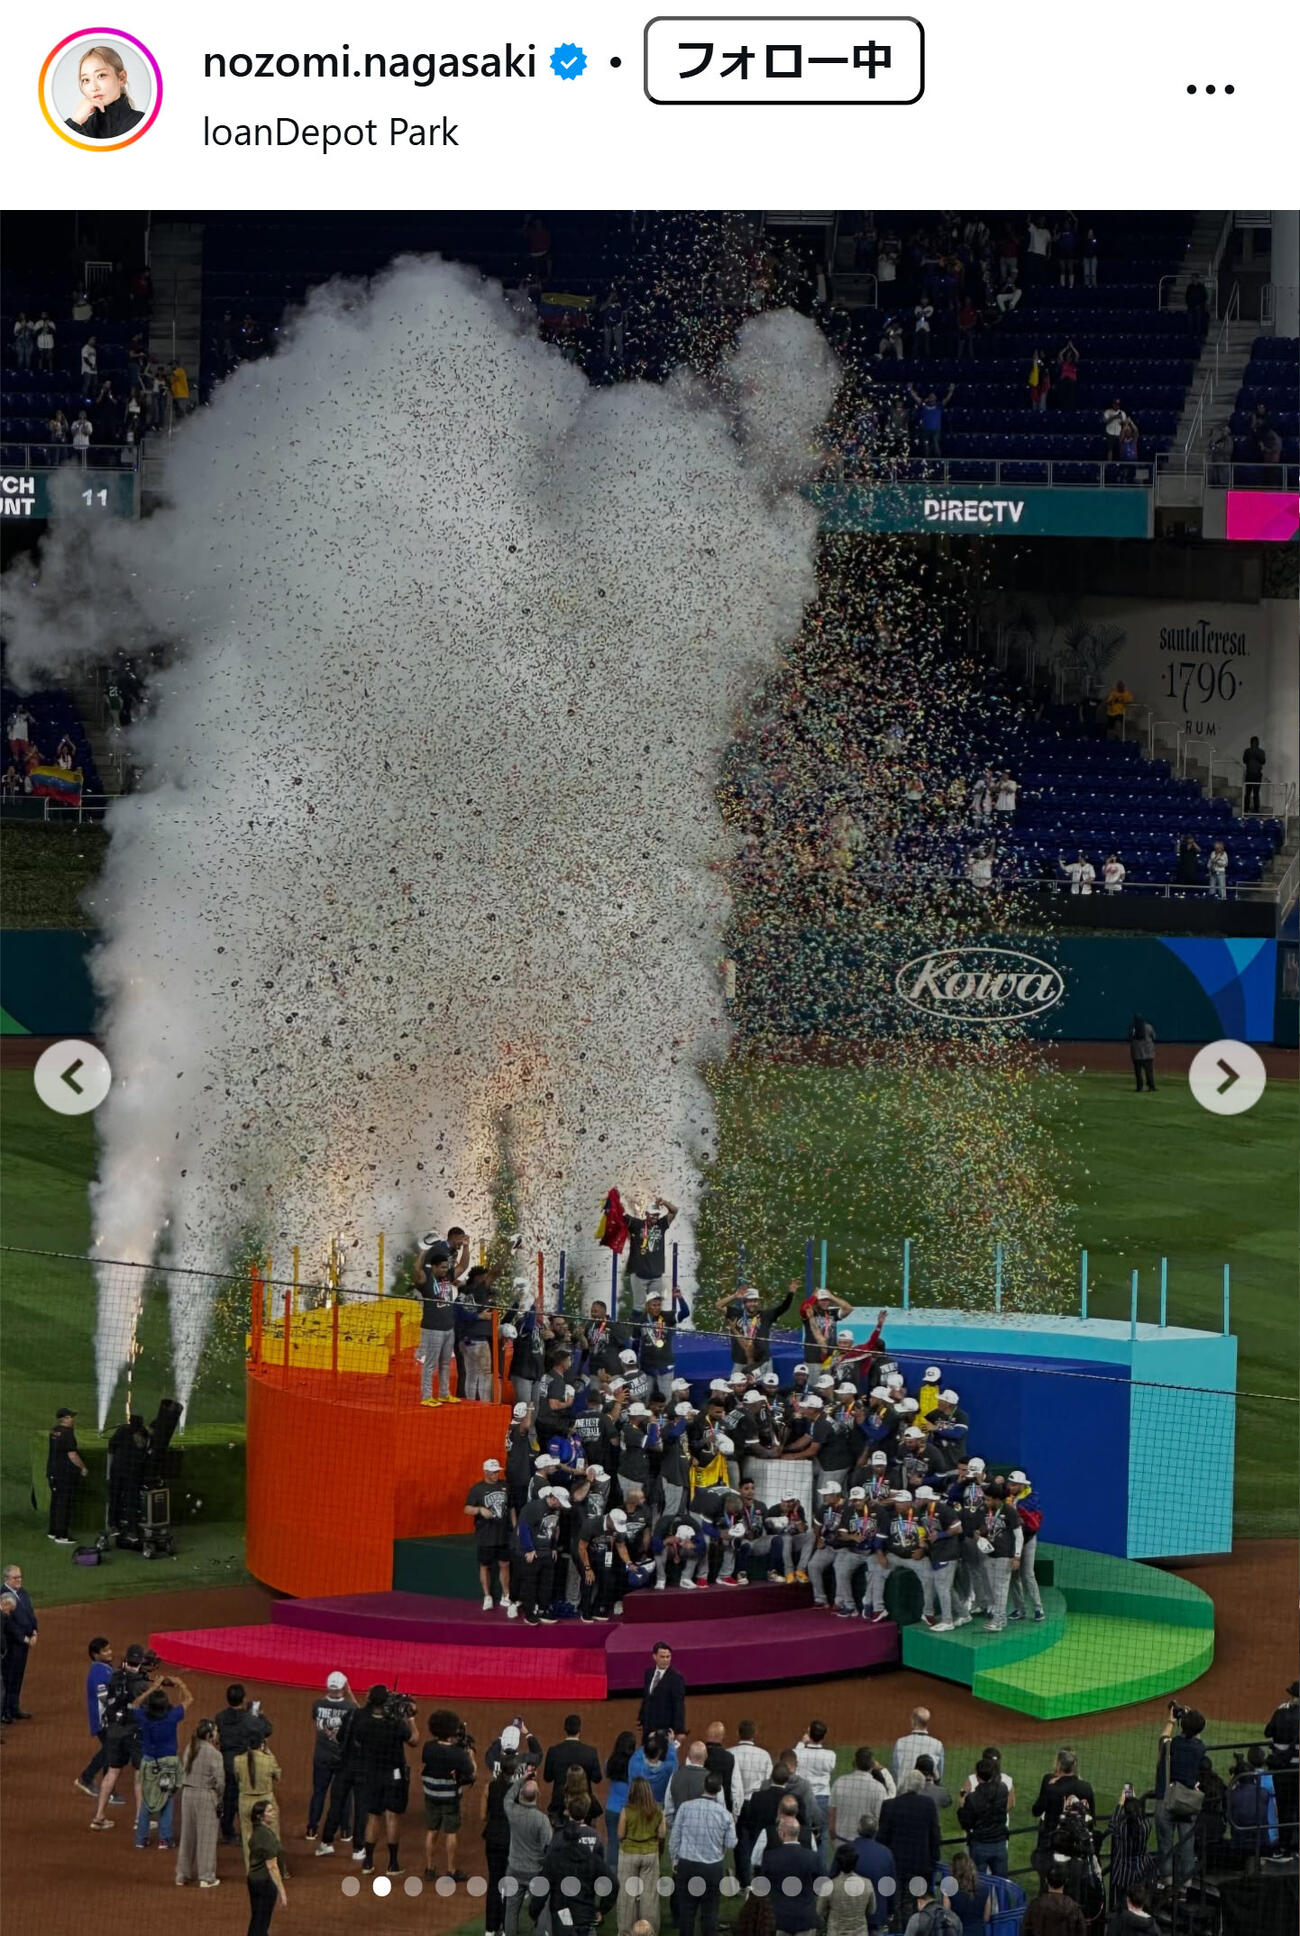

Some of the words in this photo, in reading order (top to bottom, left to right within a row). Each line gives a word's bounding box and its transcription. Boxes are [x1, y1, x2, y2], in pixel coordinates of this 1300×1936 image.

[0, 476, 35, 494] CH
[82, 489, 108, 506] 11
[924, 499, 1025, 522] DIRECTV
[1185, 720, 1216, 736] RUM
[909, 959, 1056, 1001] Kowa
